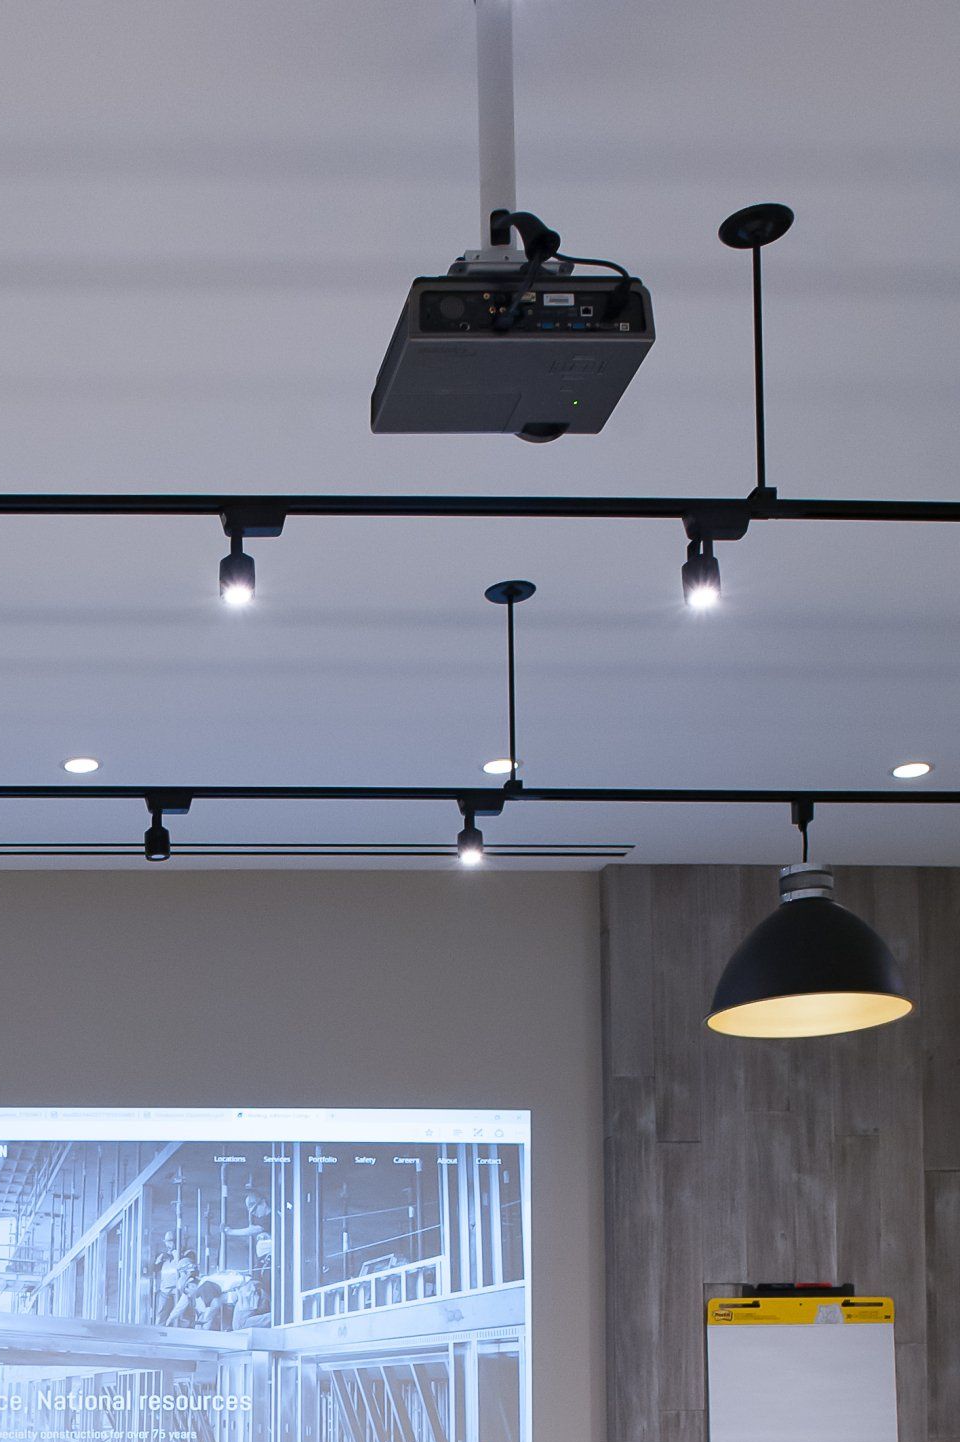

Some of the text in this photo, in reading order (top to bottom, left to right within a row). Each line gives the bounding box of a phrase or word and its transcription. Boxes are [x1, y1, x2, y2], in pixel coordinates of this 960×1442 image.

[213, 1156, 502, 1165] Locations Services Portfolio Safety Careers About Contact
[37, 1390, 131, 1412] National
[140, 1394, 252, 1412] resources
[40, 1429, 106, 1440] construction
[127, 1430, 149, 1440] over
[152, 1429, 166, 1440] 75
[169, 1430, 197, 1442] years
